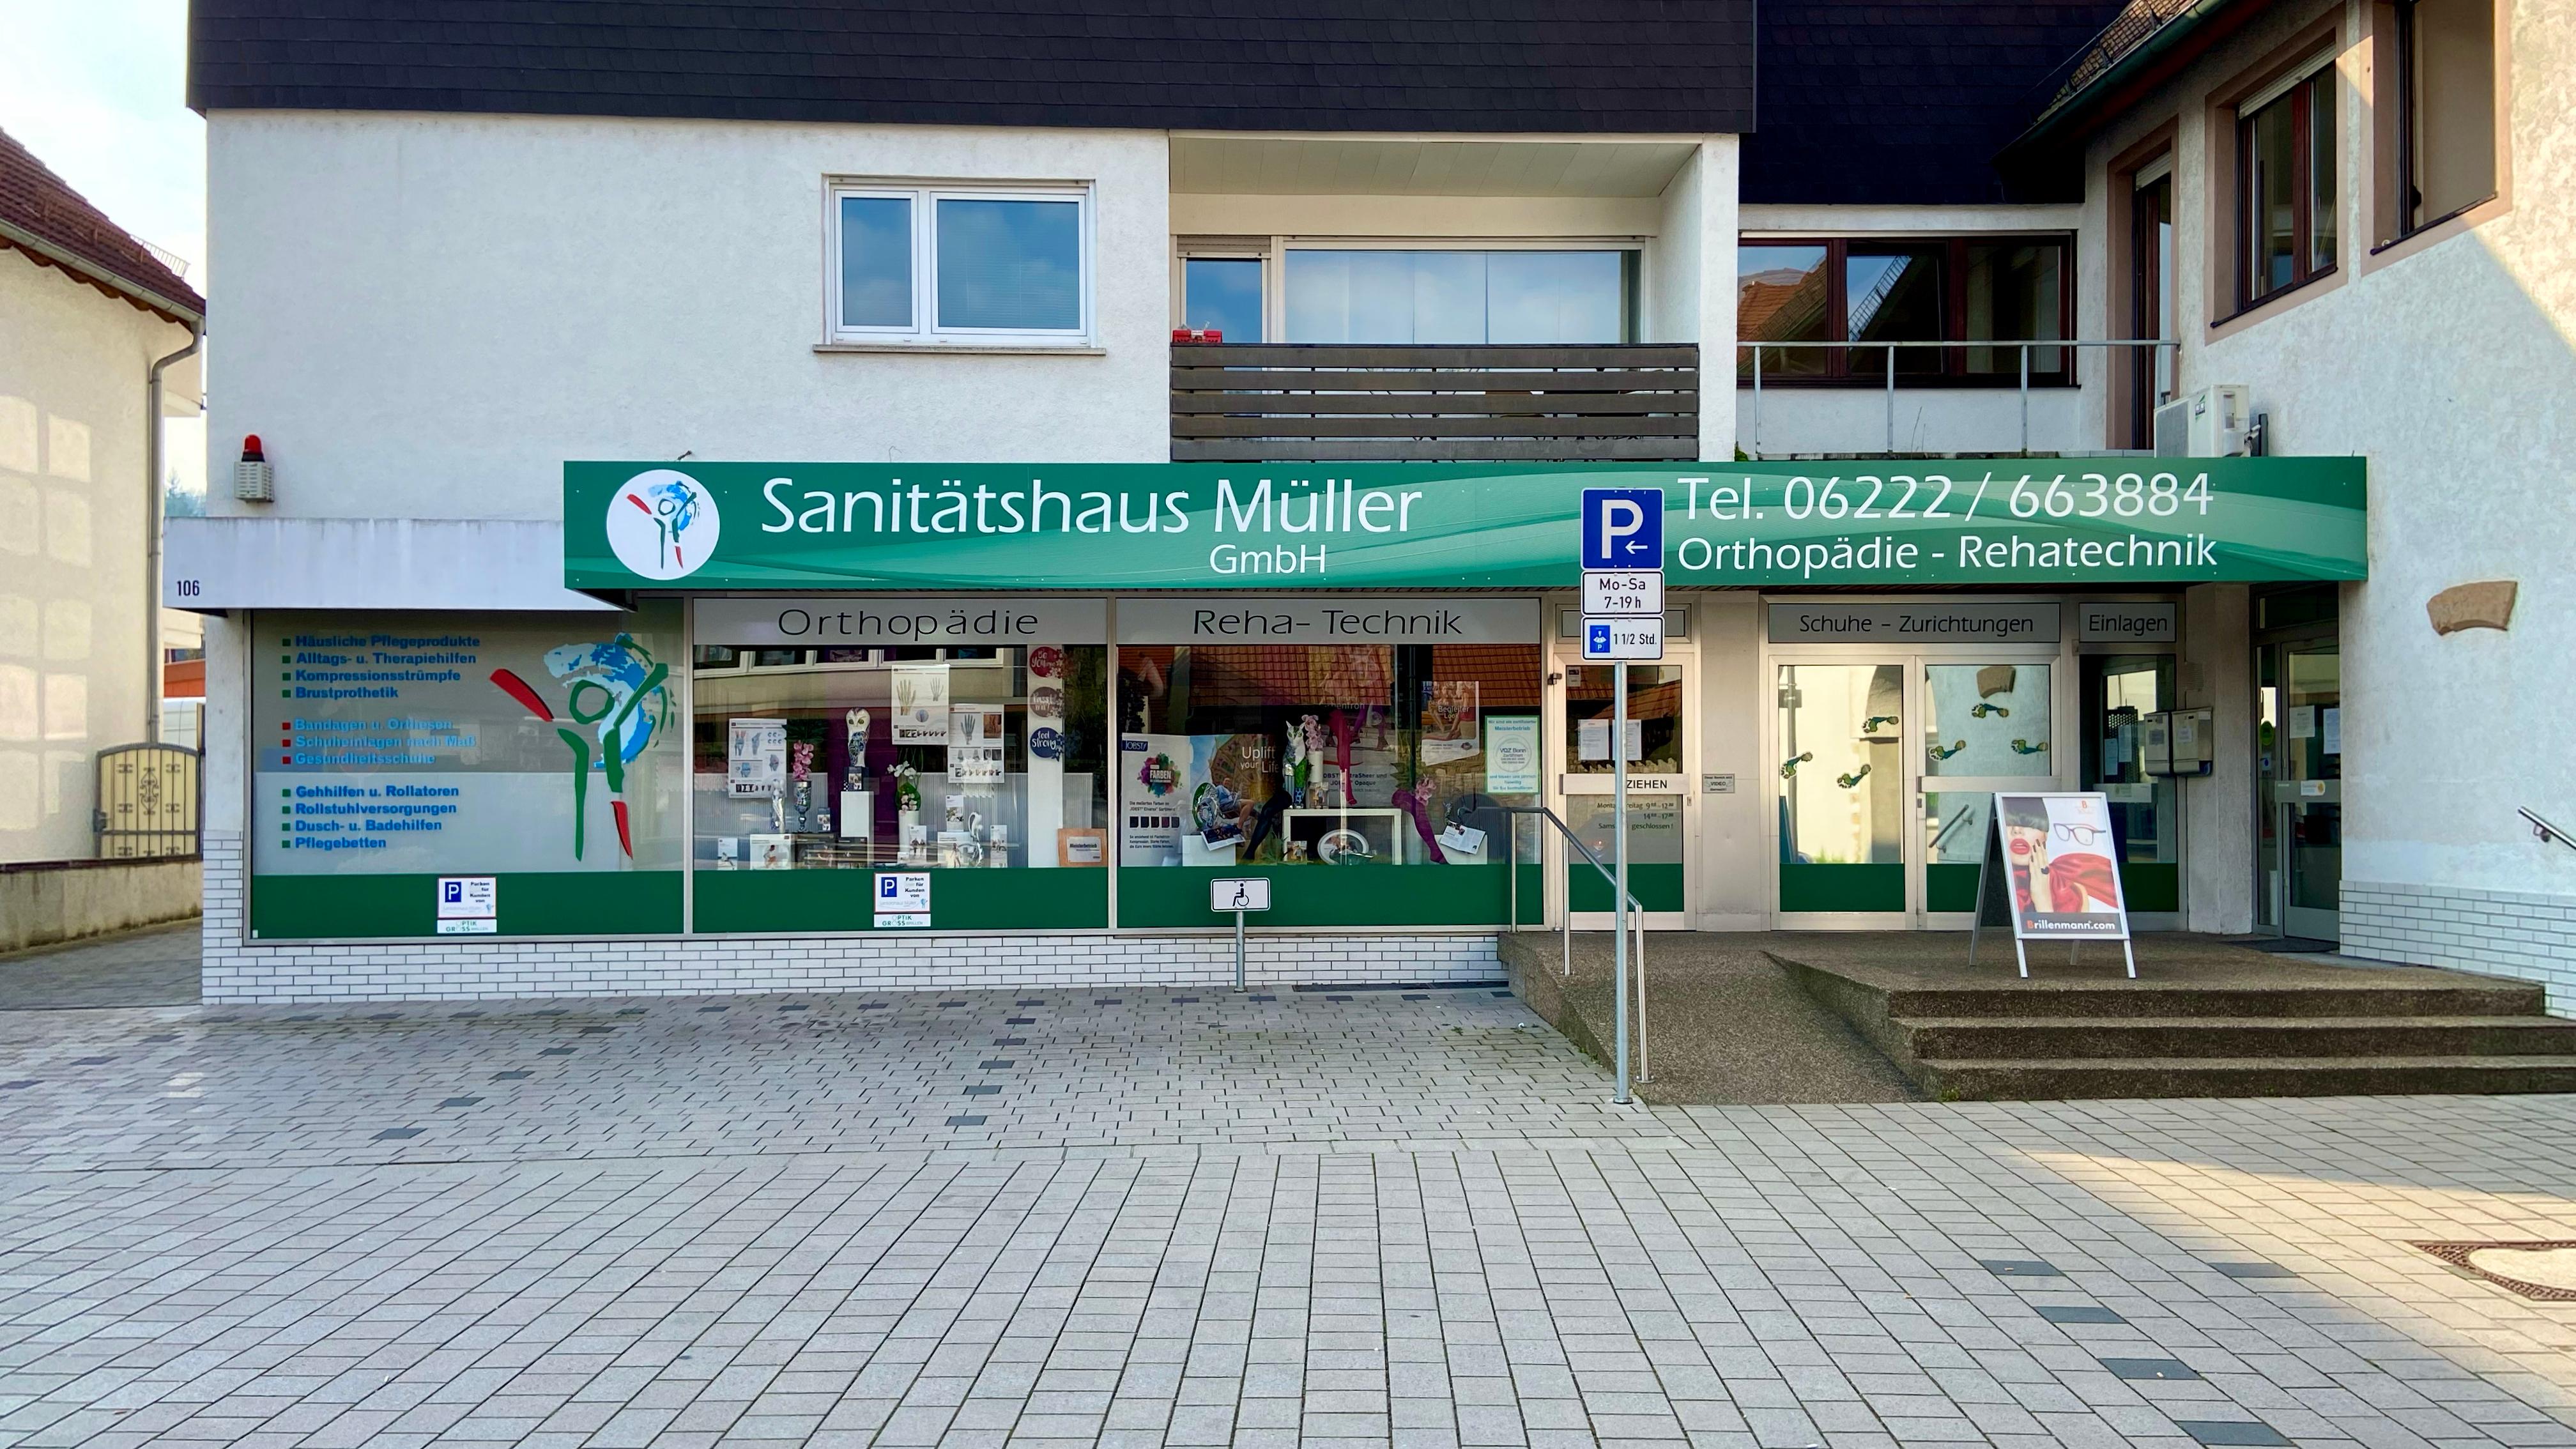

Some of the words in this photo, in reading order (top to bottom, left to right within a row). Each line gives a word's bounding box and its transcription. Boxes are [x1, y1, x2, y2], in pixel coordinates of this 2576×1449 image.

[1678, 477, 1763, 520] Tel.
[1784, 475, 1952, 519] 06222
[2010, 473, 2213, 518] 663884
[762, 478, 1189, 533] Sanitätshaus
[1215, 479, 1422, 533] Müller
[1602, 500, 1644, 559] P
[1210, 544, 1326, 574] GmbH
[1678, 536, 1918, 578] Orthopädie
[1960, 534, 2216, 567] Rehatechnik
[176, 579, 200, 596] 106
[1599, 578, 1646, 591] Mo-Sa
[1604, 596, 1632, 609] 7-19
[1635, 596, 1641, 609] h
[778, 609, 1038, 641] Orthopädie
[1193, 610, 1310, 634] Reha-
[1322, 610, 1462, 634] Technik
[1799, 615, 1873, 632] Schuhe
[1898, 615, 2034, 637] Zurichtungen
[2089, 615, 2168, 638] Einlagen
[296, 635, 367, 647] Häusliche
[371, 635, 480, 649] Pflegeprodukte
[1621, 633, 1635, 645] 1/2
[1639, 633, 1657, 645] Std.
[296, 652, 353, 666] Alltags-
[356, 655, 369, 664] u.
[372, 652, 477, 666] Therapiehilfen
[296, 670, 461, 683] Kompressionsstrümpfe
[296, 686, 399, 700] Brustprothetik
[295, 719, 367, 733] Bandagen
[387, 717, 452, 730] Orthesen
[296, 735, 402, 749] Schuheinlagen
[407, 736, 440, 747] nach
[444, 735, 476, 747] Maß
[296, 753, 435, 765] Gesundheitsschuhe
[1242, 746, 1276, 762] Uplift
[1240, 762, 1259, 770] your
[1261, 760, 1280, 773] Life
[1150, 770, 1172, 779] FARBEN
[1627, 779, 1667, 789] ZIEHEN
[296, 785, 365, 798] Gehhilfen
[369, 788, 382, 797] u.
[386, 785, 459, 797] Rollatoren
[296, 802, 457, 816] Rollstuhlversorgungen
[296, 820, 345, 832] Dusch-
[348, 822, 361, 832] u.
[365, 819, 442, 831] Badehilfen
[295, 836, 387, 851] Pflegebetten
[448, 884, 460, 901] P
[884, 879, 895, 896] P
[2026, 919, 2115, 930] Brillenmann.com
